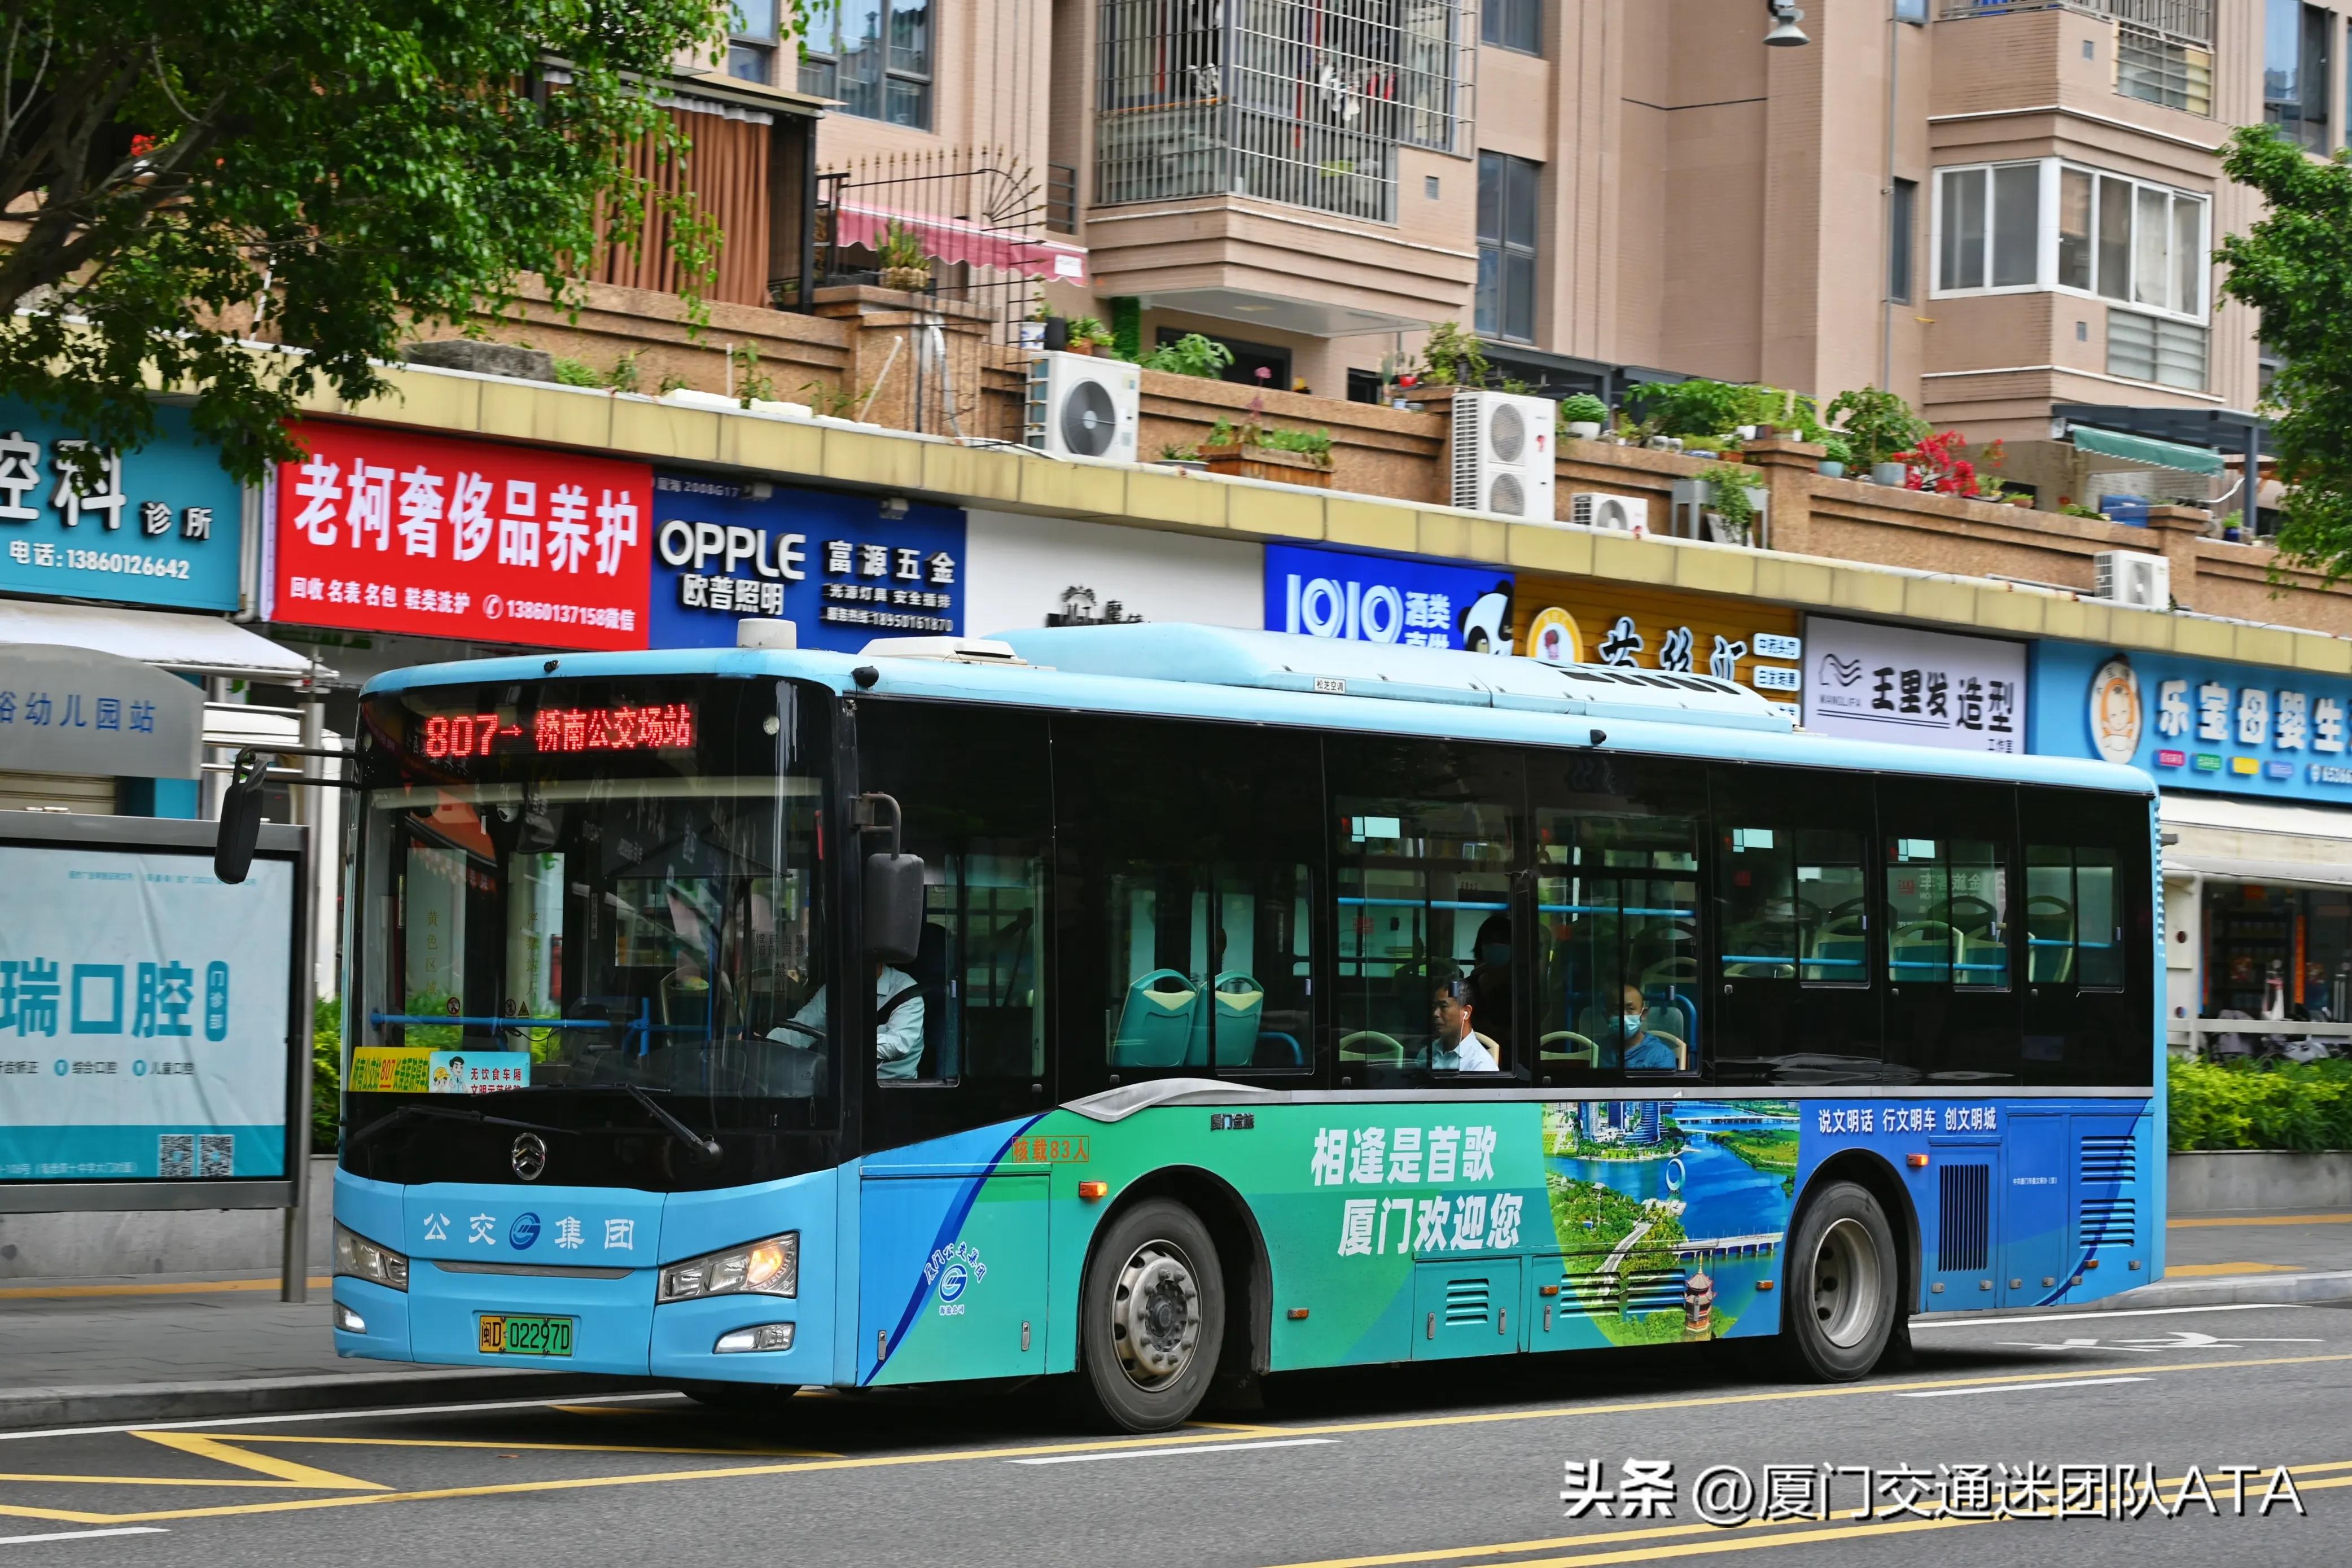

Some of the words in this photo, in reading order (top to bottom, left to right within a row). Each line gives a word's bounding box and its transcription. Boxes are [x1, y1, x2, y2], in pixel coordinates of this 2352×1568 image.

[144, 501, 214, 540] 诊所
[294, 453, 639, 577] 老柯奢侈品养护
[659, 519, 806, 580] OPPLE
[828, 540, 956, 584] 富源五金
[290, 576, 324, 601] 回收
[327, 580, 361, 604] 名表
[365, 584, 398, 608] 名包
[404, 587, 471, 615] 鞋类洗护
[682, 573, 785, 616] 欧普照明
[829, 584, 888, 602] 光源灯具
[1405, 591, 1451, 630] 酒类
[1317, 678, 1343, 692] 松芝空调
[424, 713, 499, 757] 807
[536, 704, 693, 752] 桥南公交场站
[380, 1059, 396, 1081] 807
[471, 1067, 522, 1081] 无饮食车厢
[1818, 1108, 1873, 1134] 说文明话
[1882, 1107, 1937, 1133] 行文明车
[1944, 1107, 1997, 1132] 创文明城
[1013, 1137, 1088, 1162] 核载83人
[1311, 1125, 1497, 1186] 相逢是首歌
[1337, 1193, 1523, 1257] 厦门欢迎您
[924, 1241, 987, 1285] 厦门公交集团
[939, 1304, 965, 1316] 海沧公司
